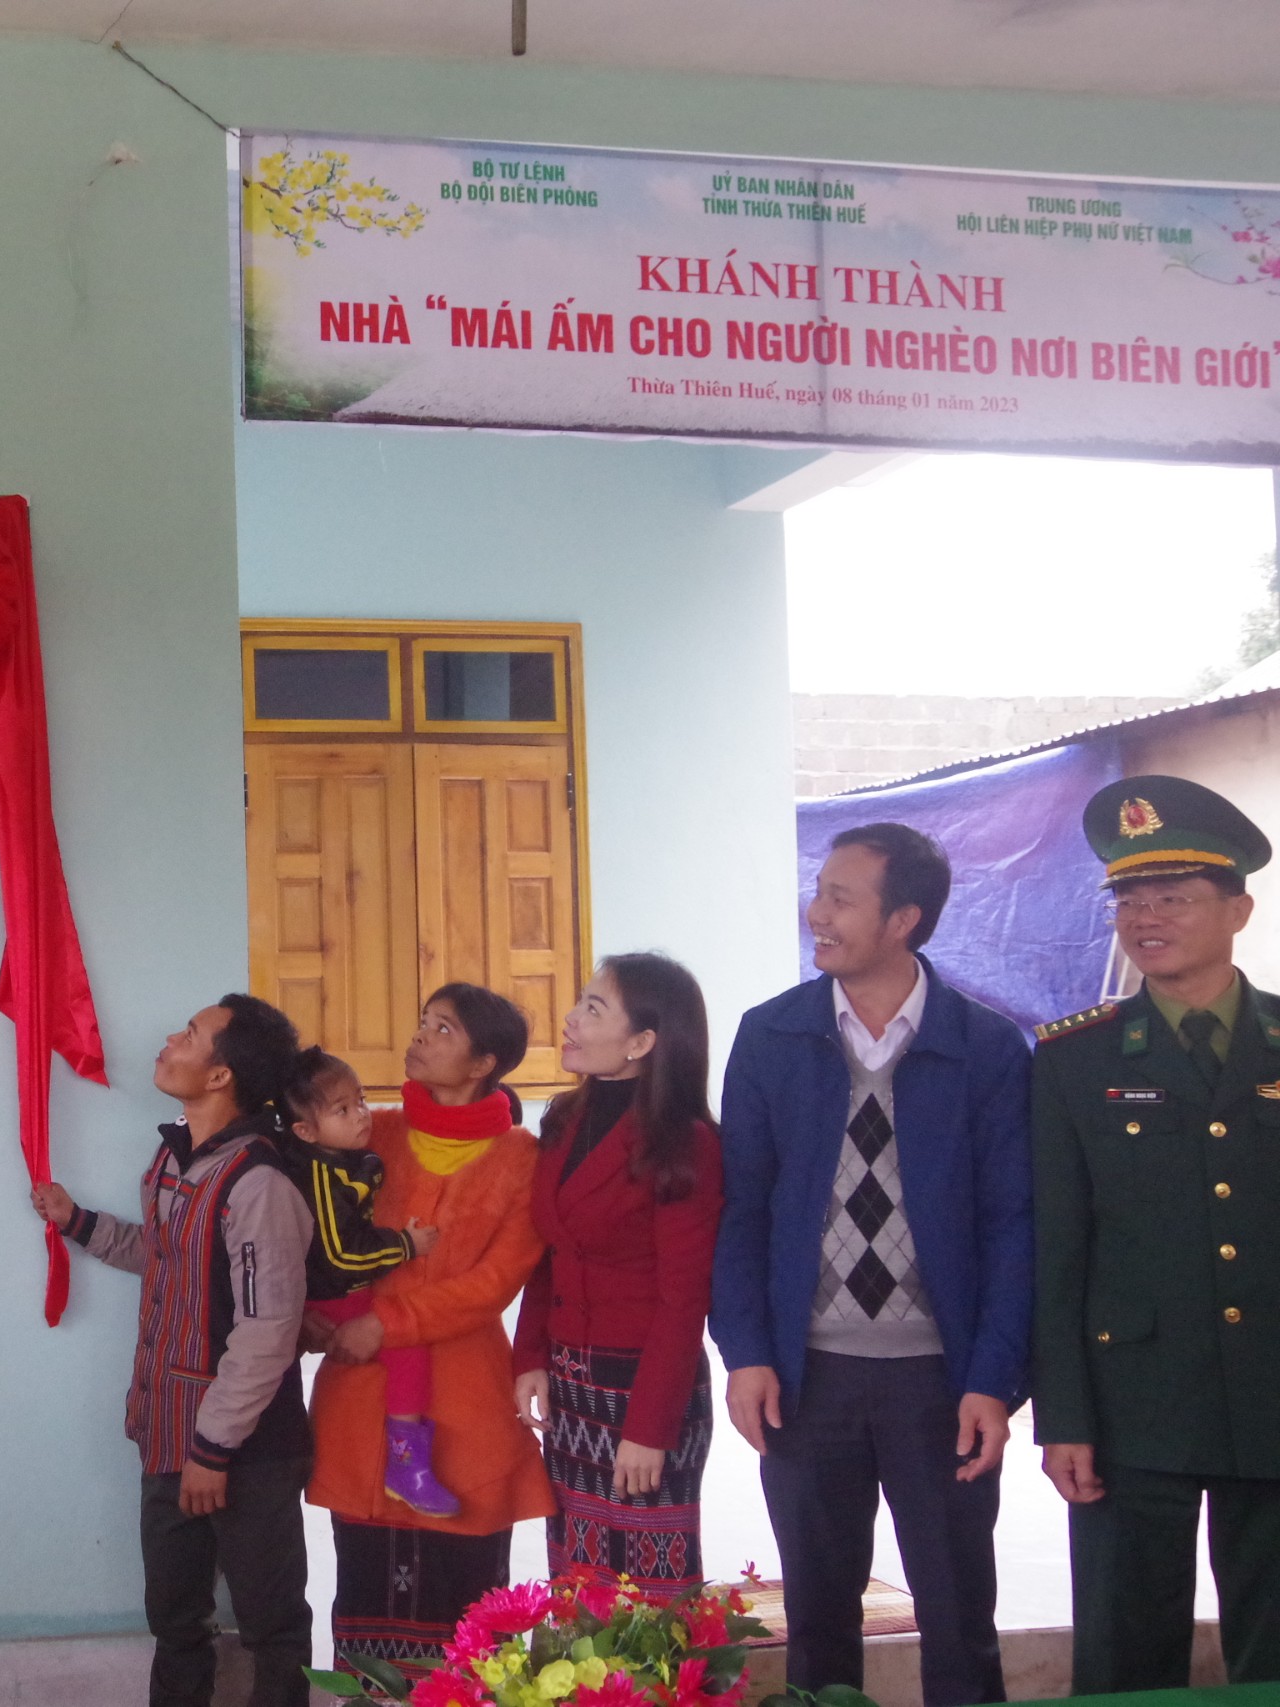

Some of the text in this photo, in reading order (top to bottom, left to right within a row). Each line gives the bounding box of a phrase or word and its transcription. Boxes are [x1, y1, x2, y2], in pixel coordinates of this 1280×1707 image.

[472, 158, 565, 184] BỘ TƯ LỆNH
[440, 180, 598, 207] BỘ ĐỘI BIÊN PHÒNG
[737, 175, 770, 194] BAN
[774, 177, 818, 198] NHÂN
[823, 179, 855, 200] DÂN
[702, 192, 867, 224] TỈNH THỪA THIÊN HUẾ
[1027, 196, 1123, 217] TRUNG ƯƠNG
[956, 211, 1193, 245] HỘI LIÊN HIỆP PHỤ NỮ VIỆT NAM
[637, 248, 1007, 312] KHÁNH THÀNH
[320, 295, 411, 344] NHÀ
[547, 297, 614, 353] ẤM
[629, 315, 712, 358] CHO
[726, 315, 851, 366] NGƯỜI
[865, 325, 997, 375] NGHÈO
[1011, 336, 1078, 379] NƠI
[1091, 336, 1181, 384] BIÊN
[627, 376, 1019, 413] Thừa Thiên Huế, ngày 08 tháng 01 năm 2023
